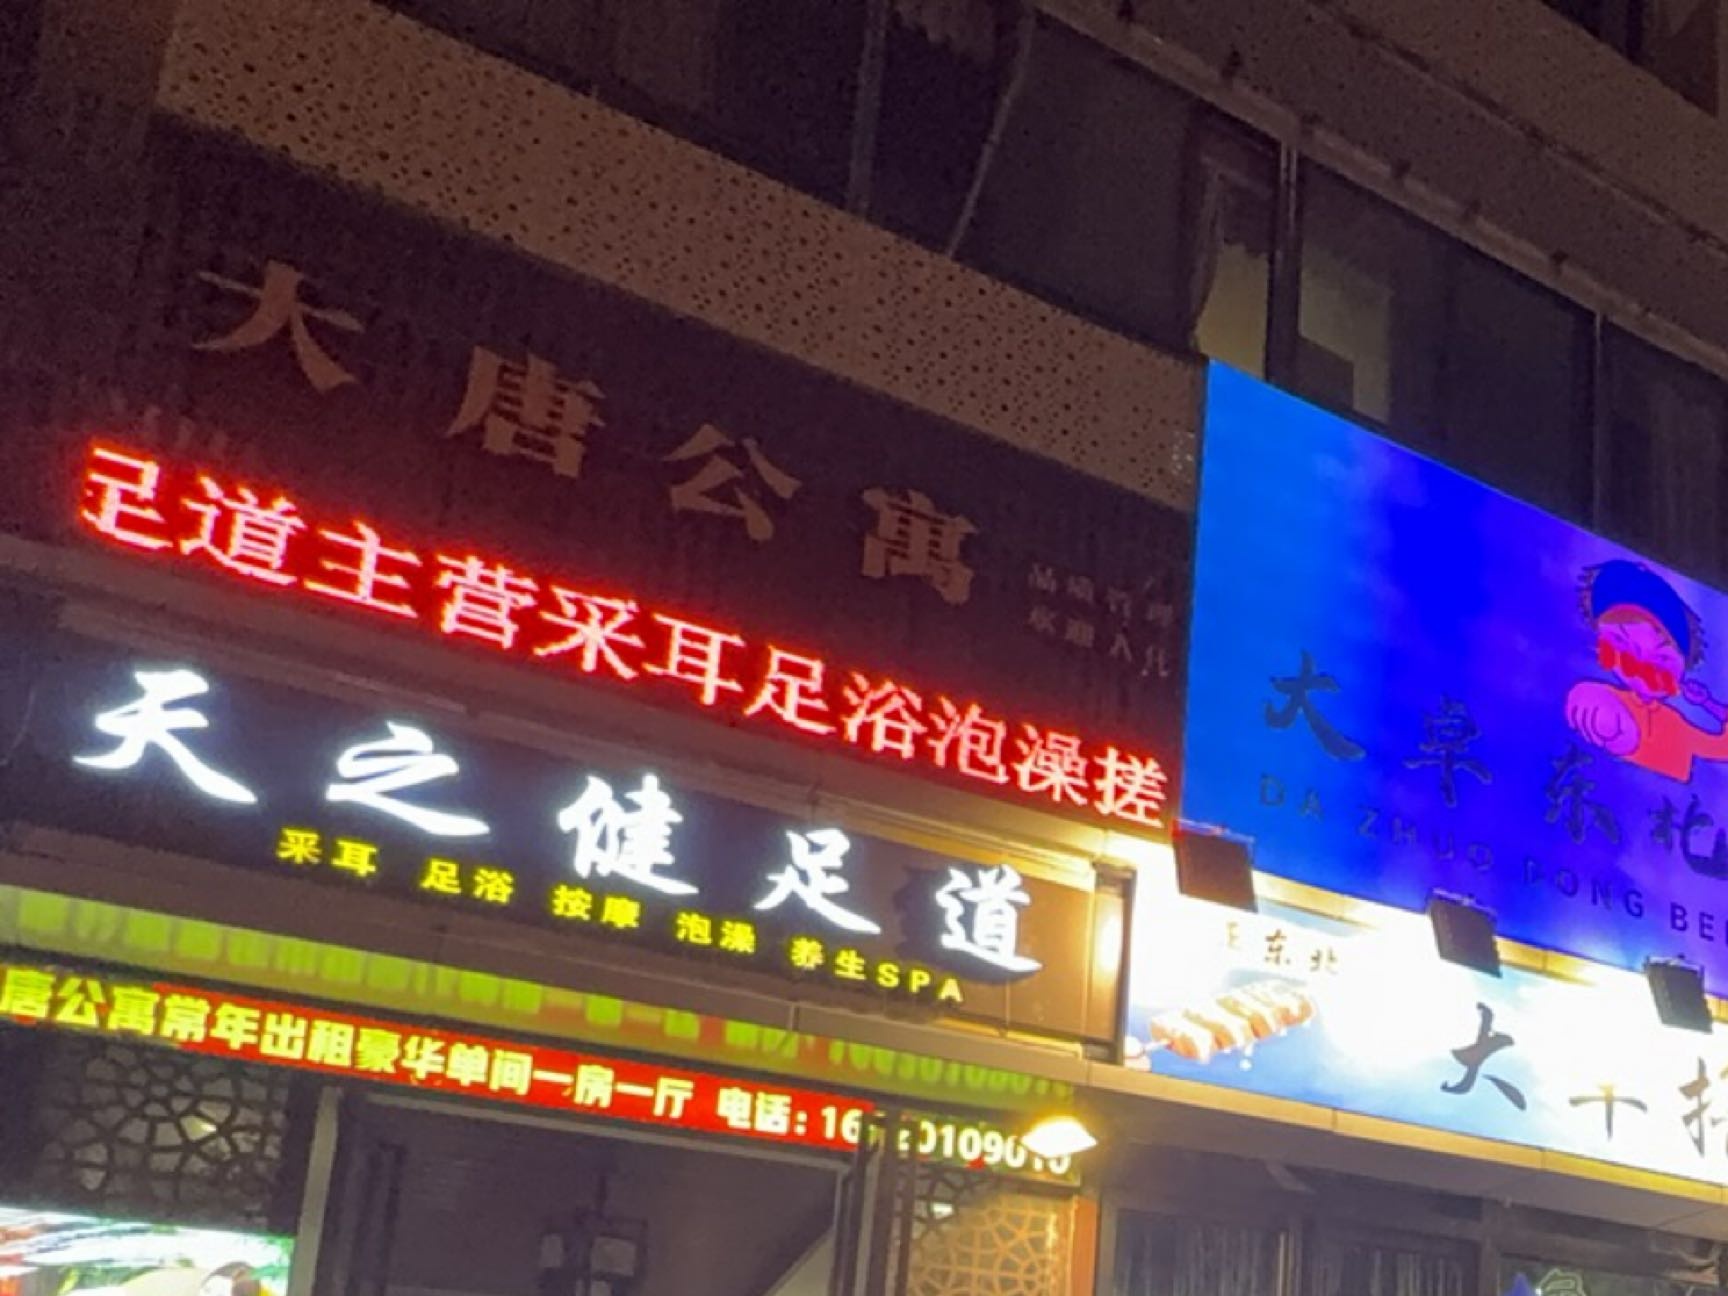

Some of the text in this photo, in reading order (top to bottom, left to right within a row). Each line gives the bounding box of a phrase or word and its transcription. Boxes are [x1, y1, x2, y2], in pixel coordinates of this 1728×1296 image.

[192, 258, 978, 604] 大唐公寓
[80, 445, 1166, 830] 足道主营采耳足浴泡澡搓
[73, 668, 1043, 973] 天之健足道
[277, 827, 964, 1003] 采耳 足浴 按摩 泡澡 养生SPA
[1258, 773, 1324, 822] DA
[1523, 857, 1645, 918] DONG
[0, 968, 695, 1120] 唐公寓常年出租豪华单间一房一厅
